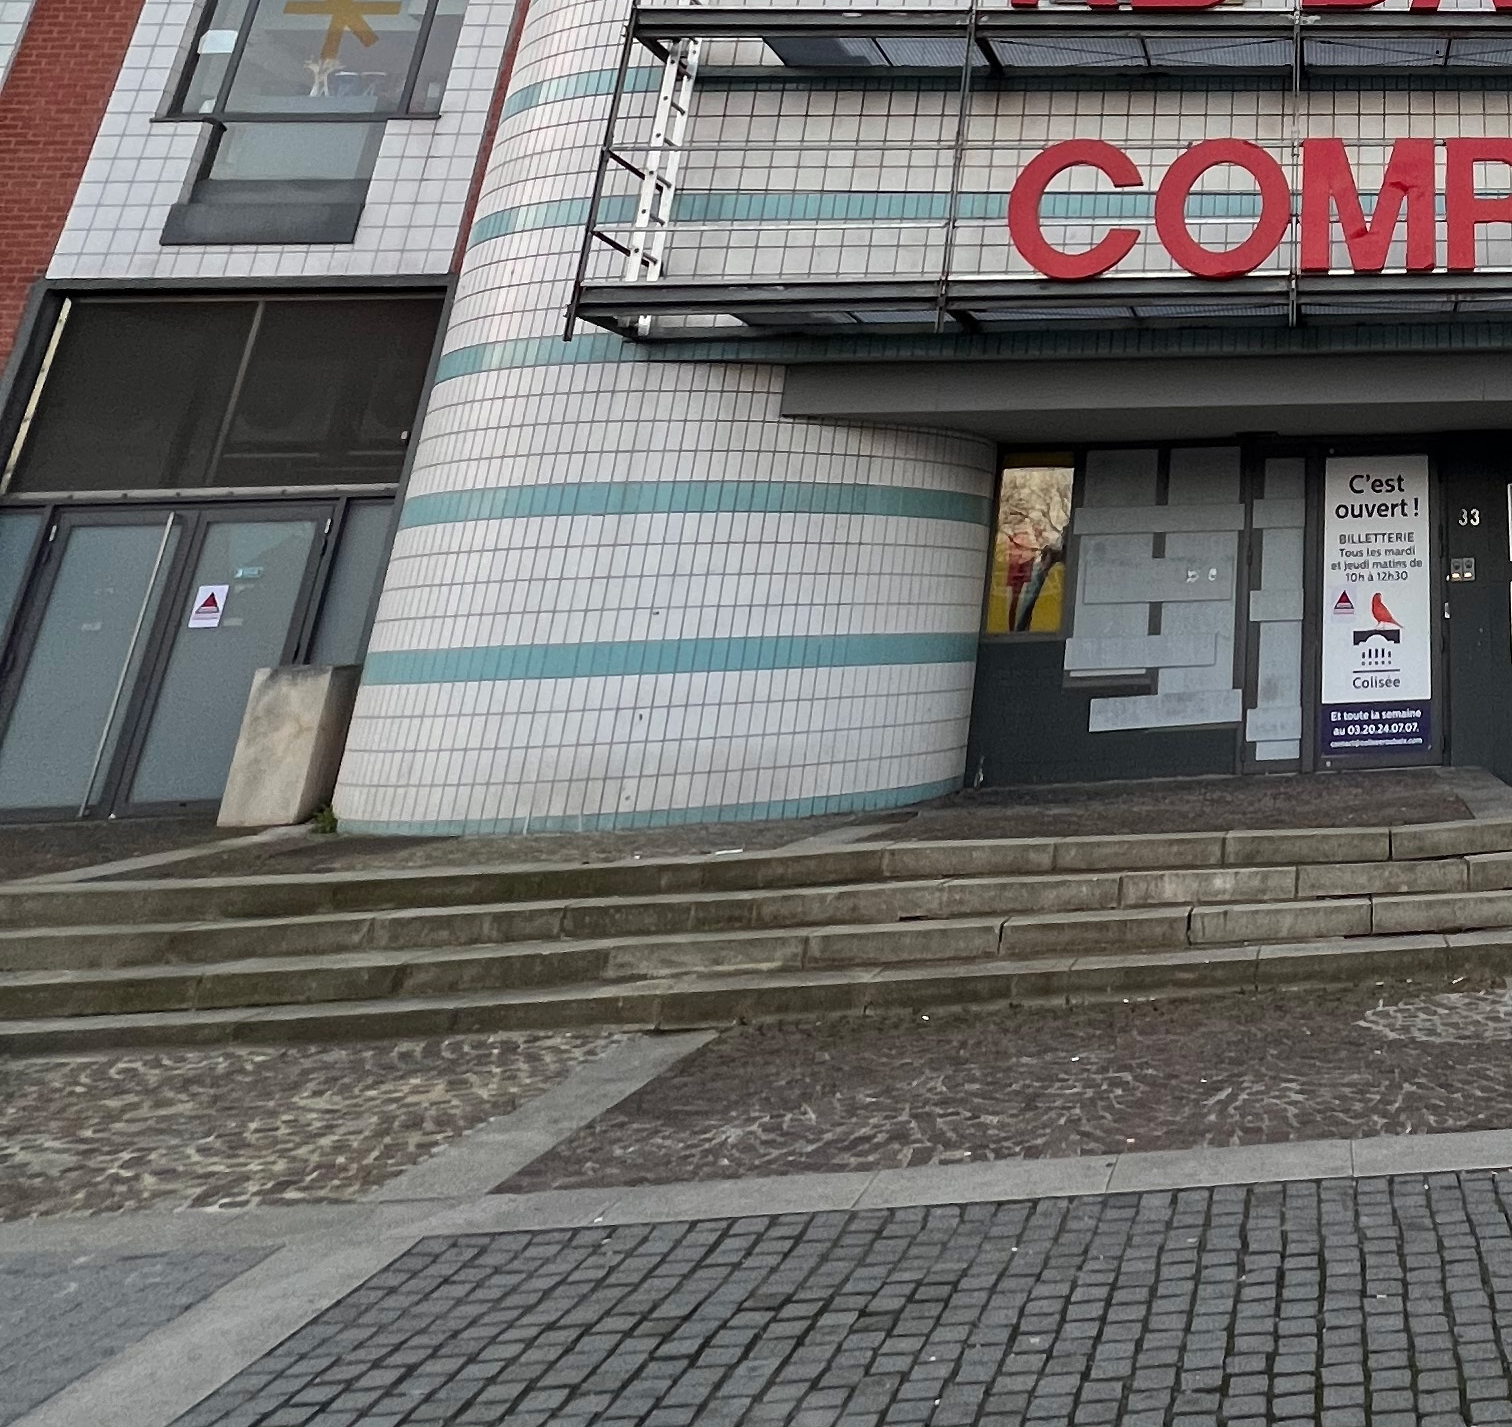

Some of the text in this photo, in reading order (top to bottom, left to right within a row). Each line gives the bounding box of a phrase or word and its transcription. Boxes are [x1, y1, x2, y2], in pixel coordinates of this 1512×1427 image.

[1348, 474, 1405, 494] C'est
[1334, 498, 1408, 519] ouvert
[1458, 508, 1480, 526] 33
[1338, 532, 1415, 545] BILLETTERIE
[1339, 545, 1416, 558] Tous les mardi
[1330, 557, 1423, 571] et jeudi matins de
[1345, 570, 1408, 583] 10h à 12h30
[1352, 674, 1401, 689] Colisée
[1330, 708, 1422, 722] Et toute la semaine
[1333, 727, 1346, 736] au
